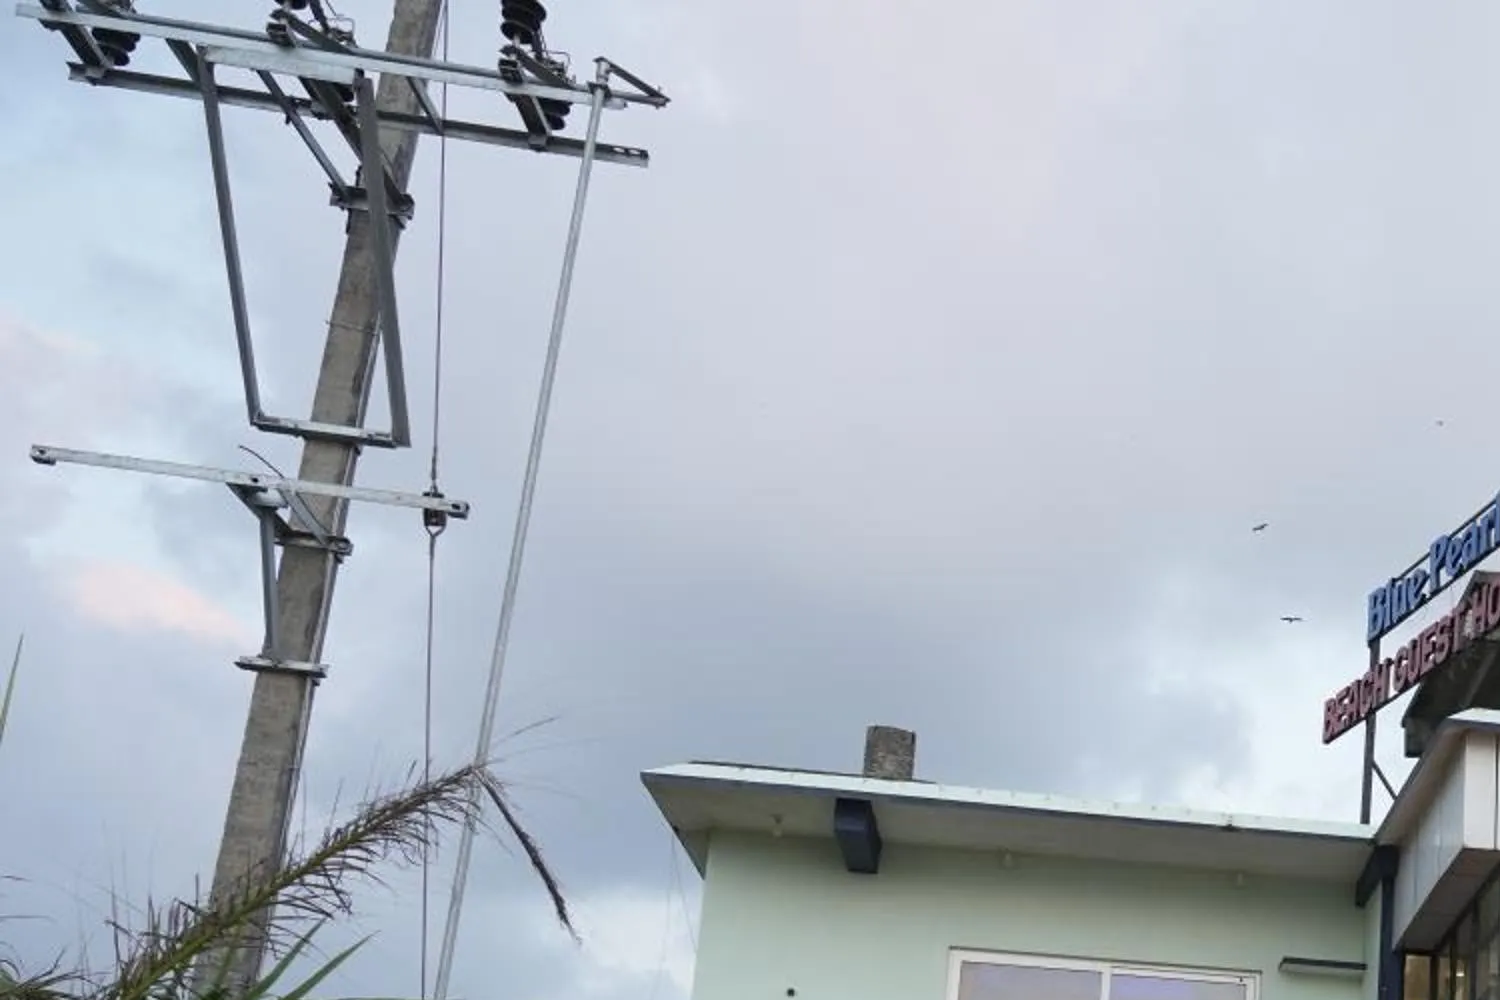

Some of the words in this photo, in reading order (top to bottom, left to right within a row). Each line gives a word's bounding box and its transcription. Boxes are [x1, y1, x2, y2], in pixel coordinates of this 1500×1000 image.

[1368, 569, 1429, 638] Blue
[1323, 661, 1393, 743] BEACH
[1394, 604, 1468, 688] GUEST
